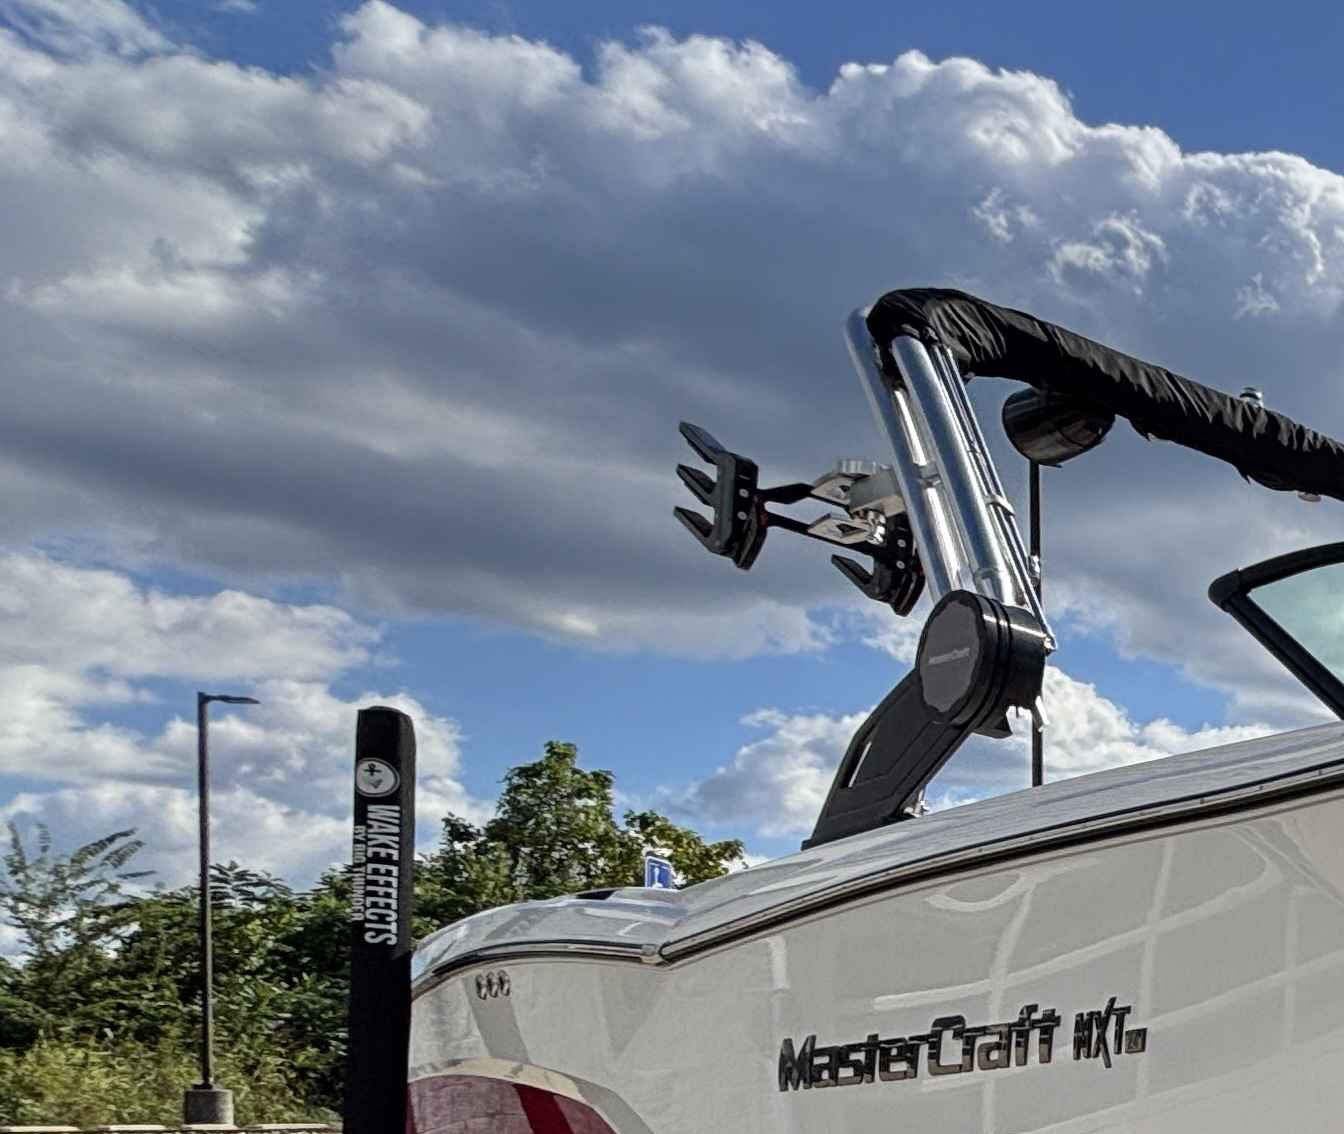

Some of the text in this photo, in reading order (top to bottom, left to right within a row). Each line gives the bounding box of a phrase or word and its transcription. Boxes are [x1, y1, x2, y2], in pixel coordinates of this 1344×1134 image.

[354, 825, 366, 841] BY
[364, 804, 400, 945] WAKE EFFECTS
[778, 1004, 1061, 1091] MasterCraft
